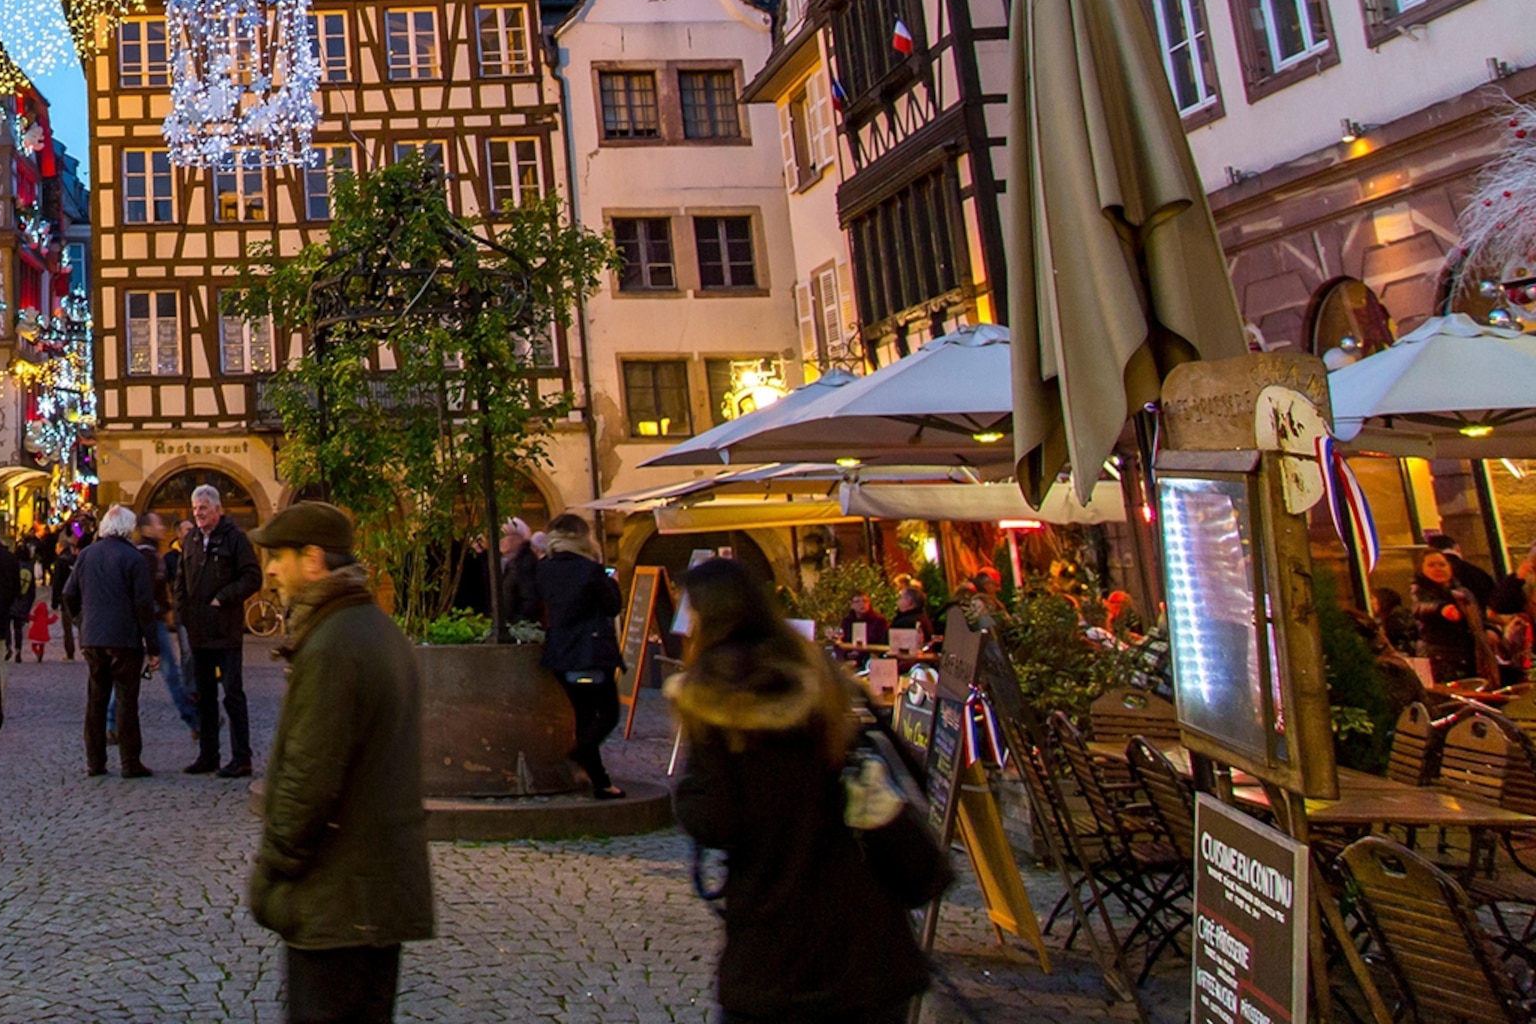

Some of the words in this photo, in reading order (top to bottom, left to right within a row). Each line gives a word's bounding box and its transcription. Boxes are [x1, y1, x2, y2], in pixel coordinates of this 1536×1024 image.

[152, 438, 249, 455] Restaurant
[1201, 831, 1238, 876] CUISINE
[1237, 852, 1250, 884] EN
[1250, 858, 1293, 909] CONTINU
